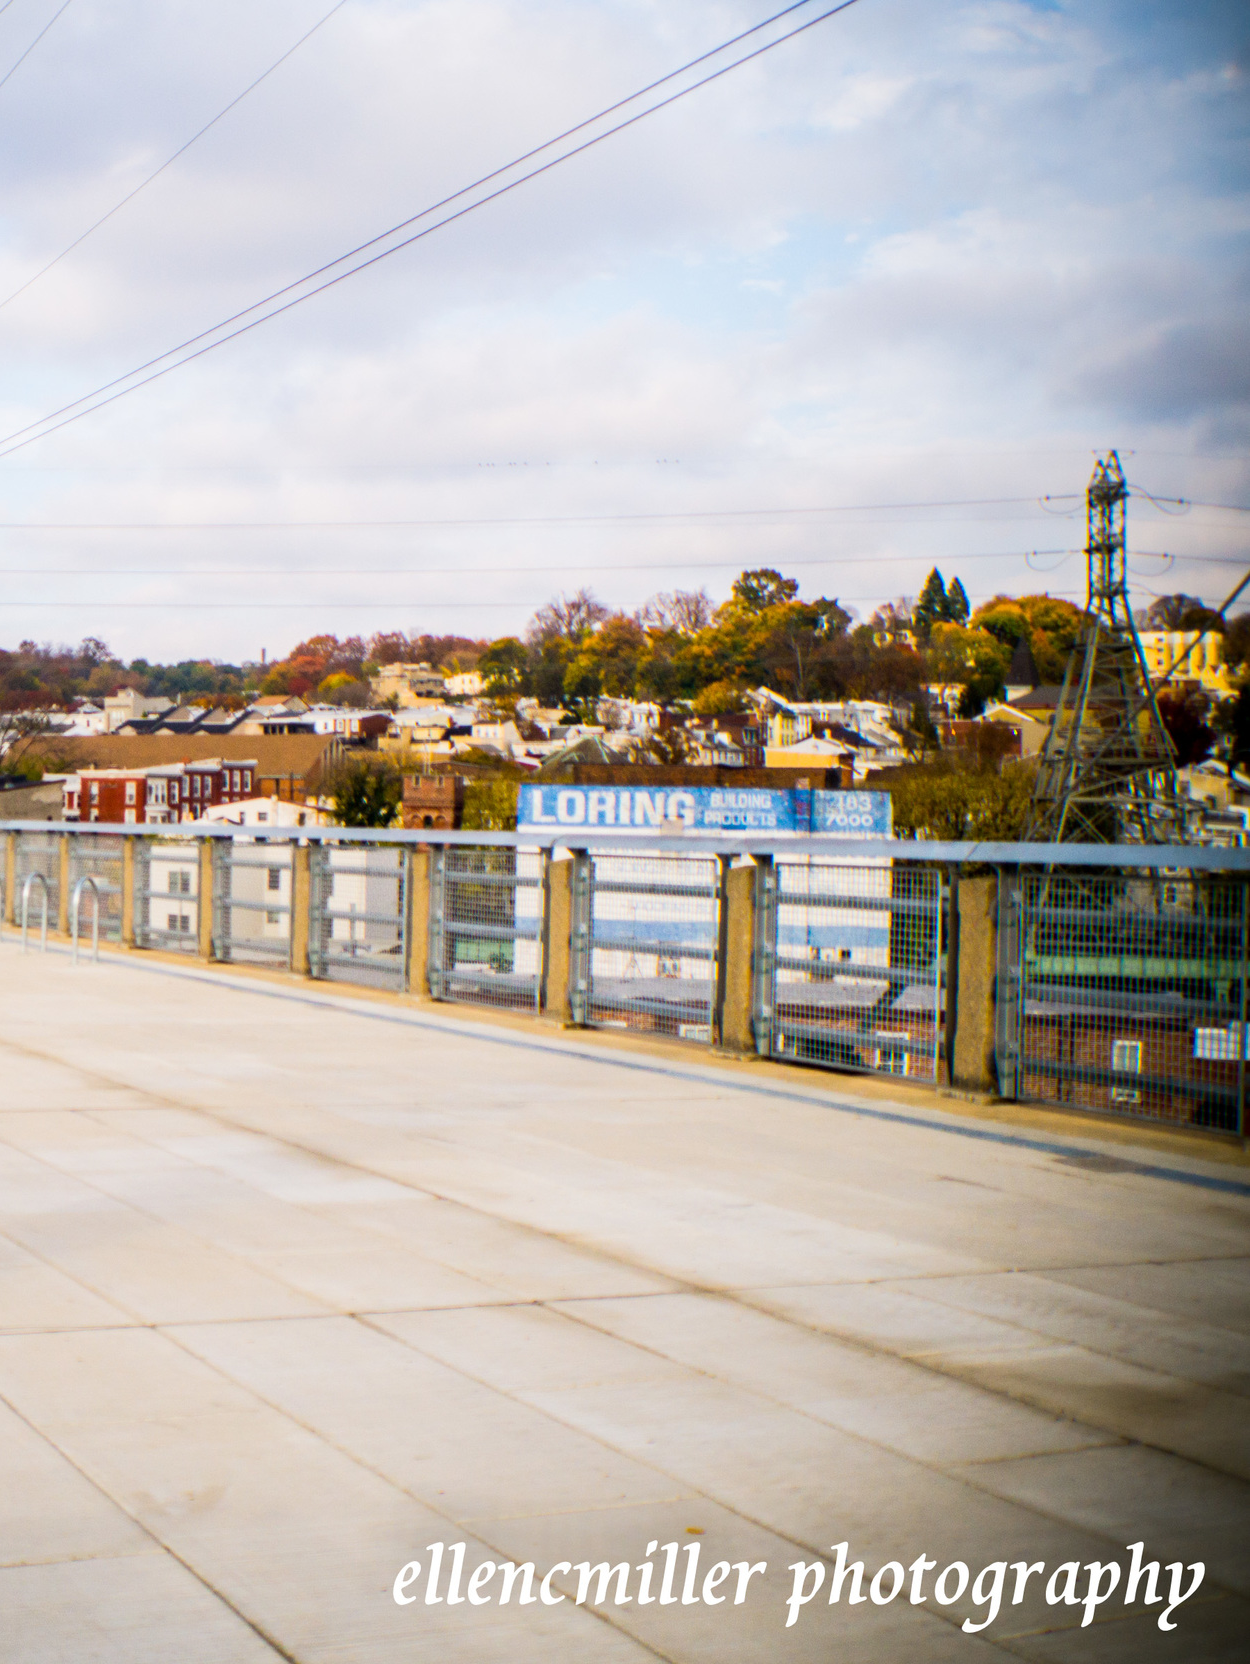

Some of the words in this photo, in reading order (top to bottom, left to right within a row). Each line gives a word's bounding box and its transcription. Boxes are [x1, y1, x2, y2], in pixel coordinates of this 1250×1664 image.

[532, 788, 696, 825] LORING
[710, 792, 772, 809] BUILDING
[703, 810, 777, 827] PRODUCTS
[825, 813, 874, 827] 7000
